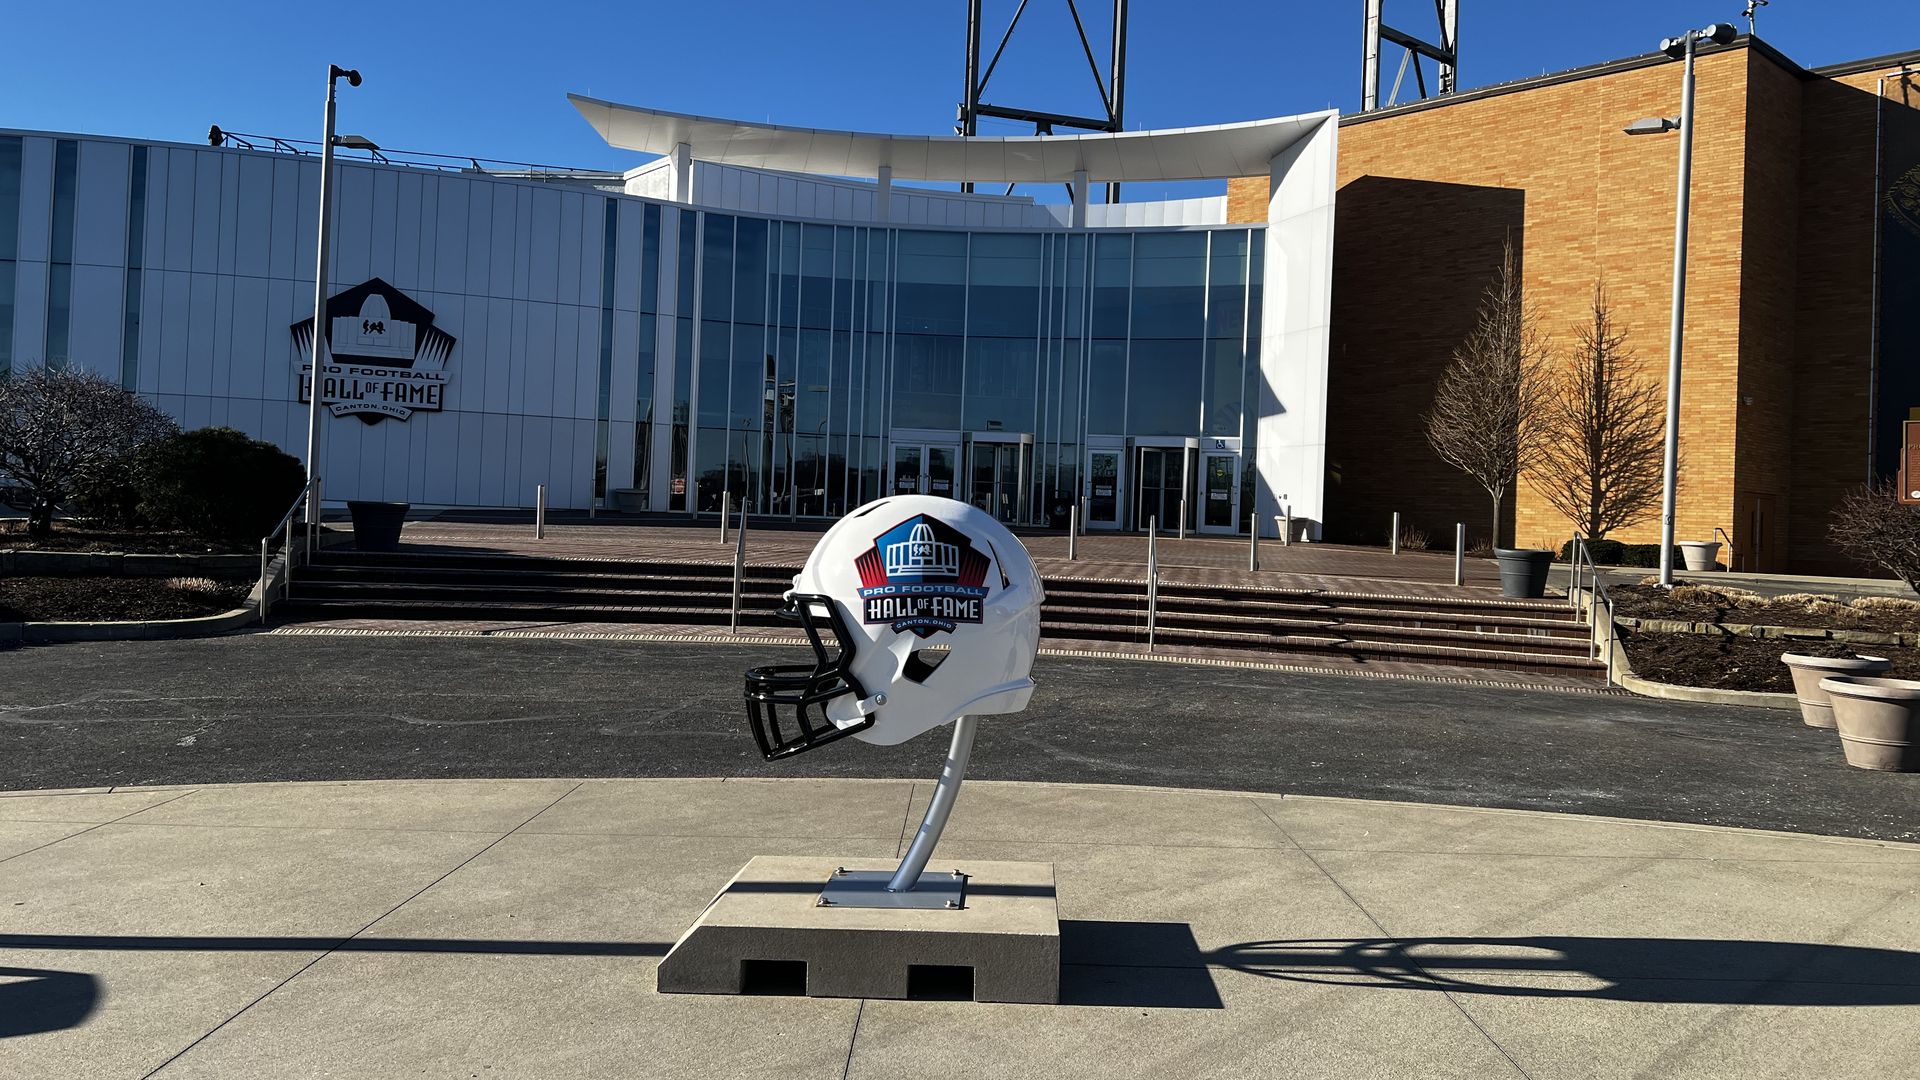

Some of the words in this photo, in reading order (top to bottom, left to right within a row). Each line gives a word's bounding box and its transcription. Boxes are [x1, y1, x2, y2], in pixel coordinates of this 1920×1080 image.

[349, 367, 445, 381] FOOTBALL
[365, 381, 379, 393] OF
[380, 381, 438, 405] FAME
[382, 405, 406, 416] OHIO
[863, 586, 896, 597] PRO
[901, 585, 983, 596] FOOTBALL
[867, 597, 918, 619] HALL
[917, 598, 929, 609] OF
[930, 597, 979, 619] FAME
[932, 619, 952, 629] OHIO
